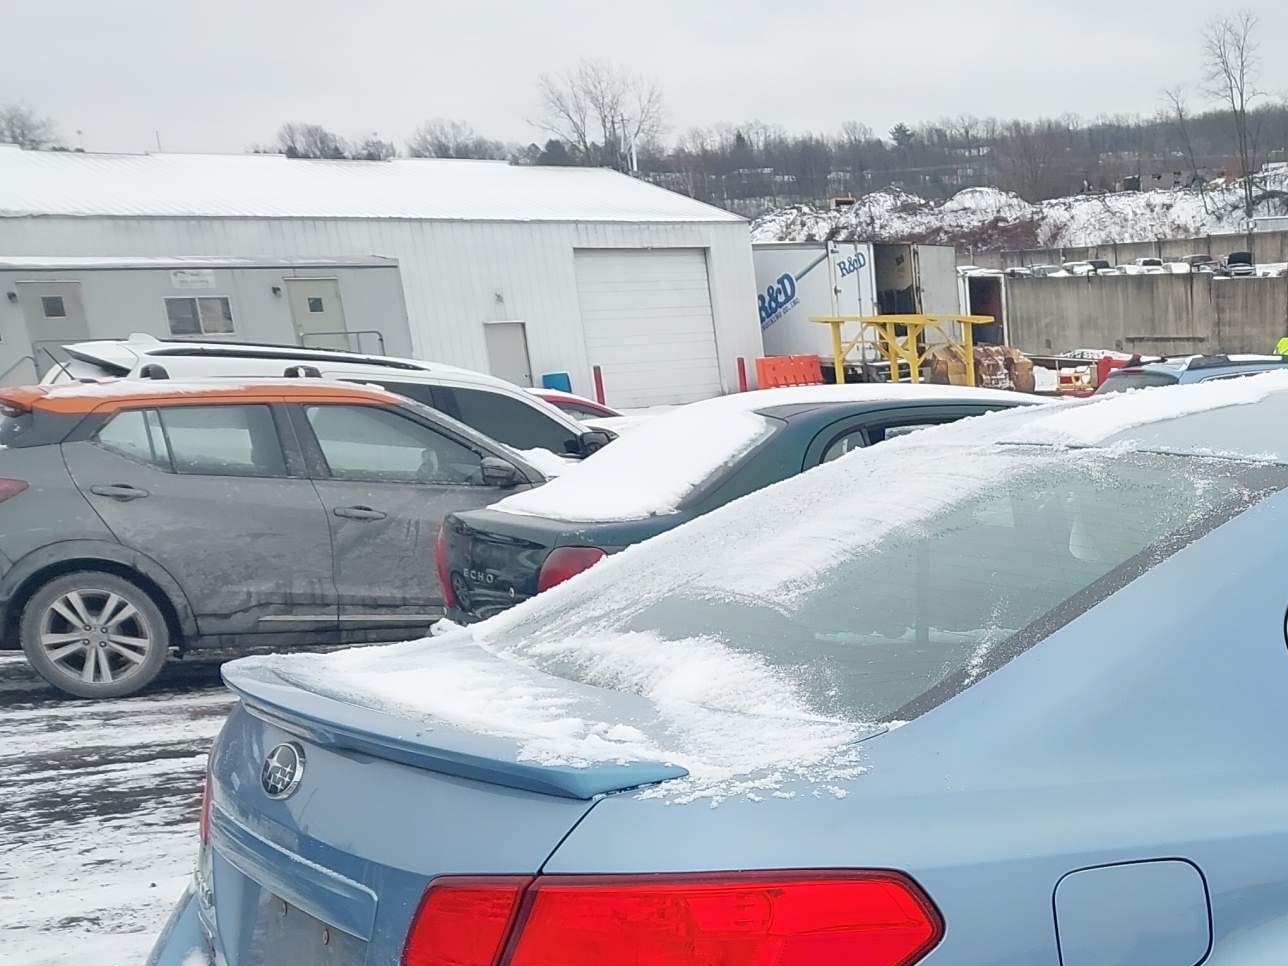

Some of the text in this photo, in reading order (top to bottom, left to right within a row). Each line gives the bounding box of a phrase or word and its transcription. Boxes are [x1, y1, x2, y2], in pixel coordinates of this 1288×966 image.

[837, 252, 866, 278] R&D
[758, 272, 796, 325] R&D
[463, 567, 494, 585] ECHO
